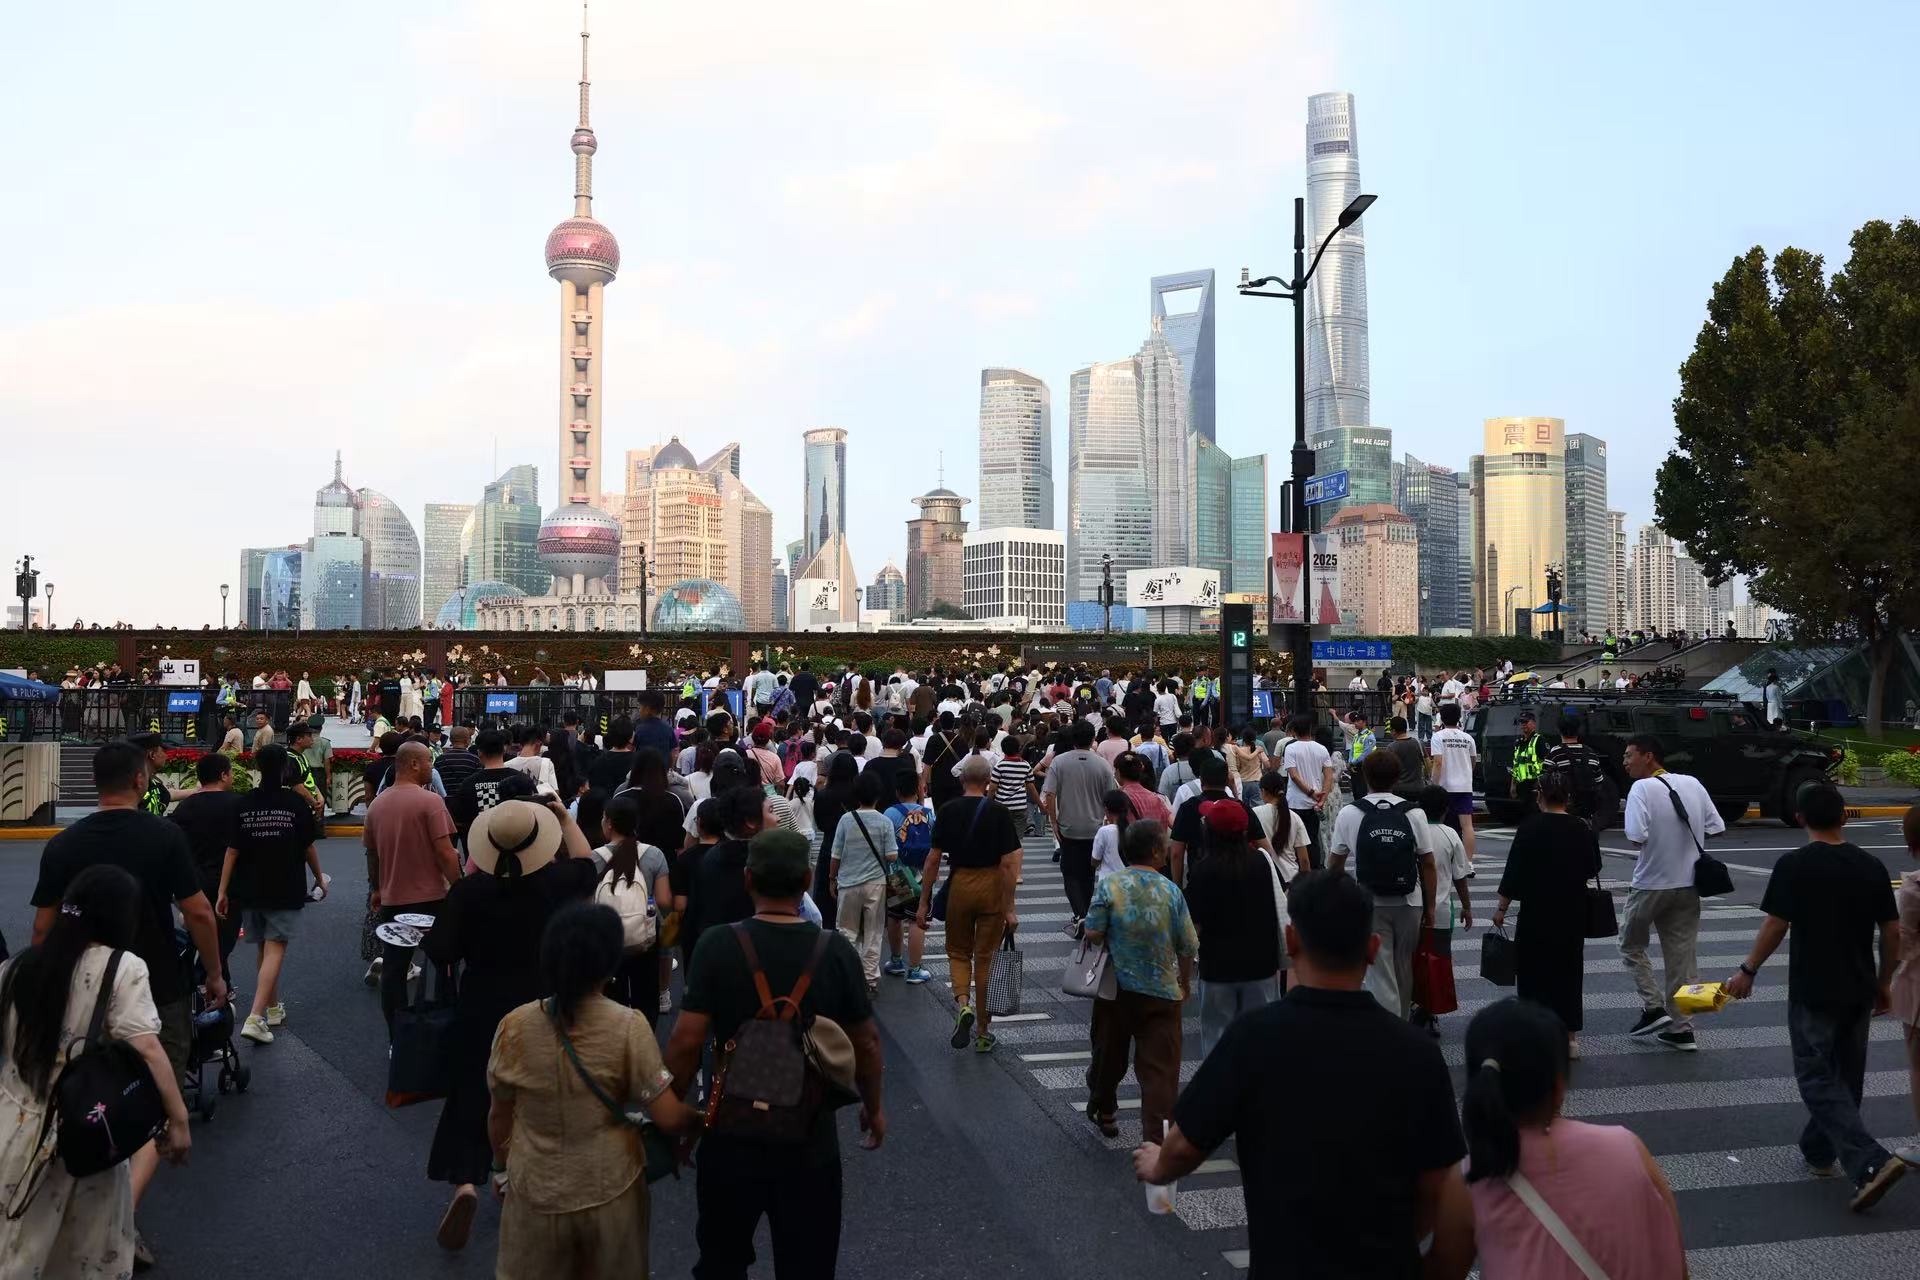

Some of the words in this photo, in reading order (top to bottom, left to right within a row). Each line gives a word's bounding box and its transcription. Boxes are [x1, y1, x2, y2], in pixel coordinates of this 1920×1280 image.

[1504, 424, 1552, 446] 震旦
[1313, 554, 1337, 566] 2025
[1233, 632, 1246, 647] 12
[1327, 645, 1376, 657] 中山东一路
[163, 663, 195, 674] 出口
[20, 688, 40, 699] POLICE
[1369, 828, 1393, 839] ATHLETIC
